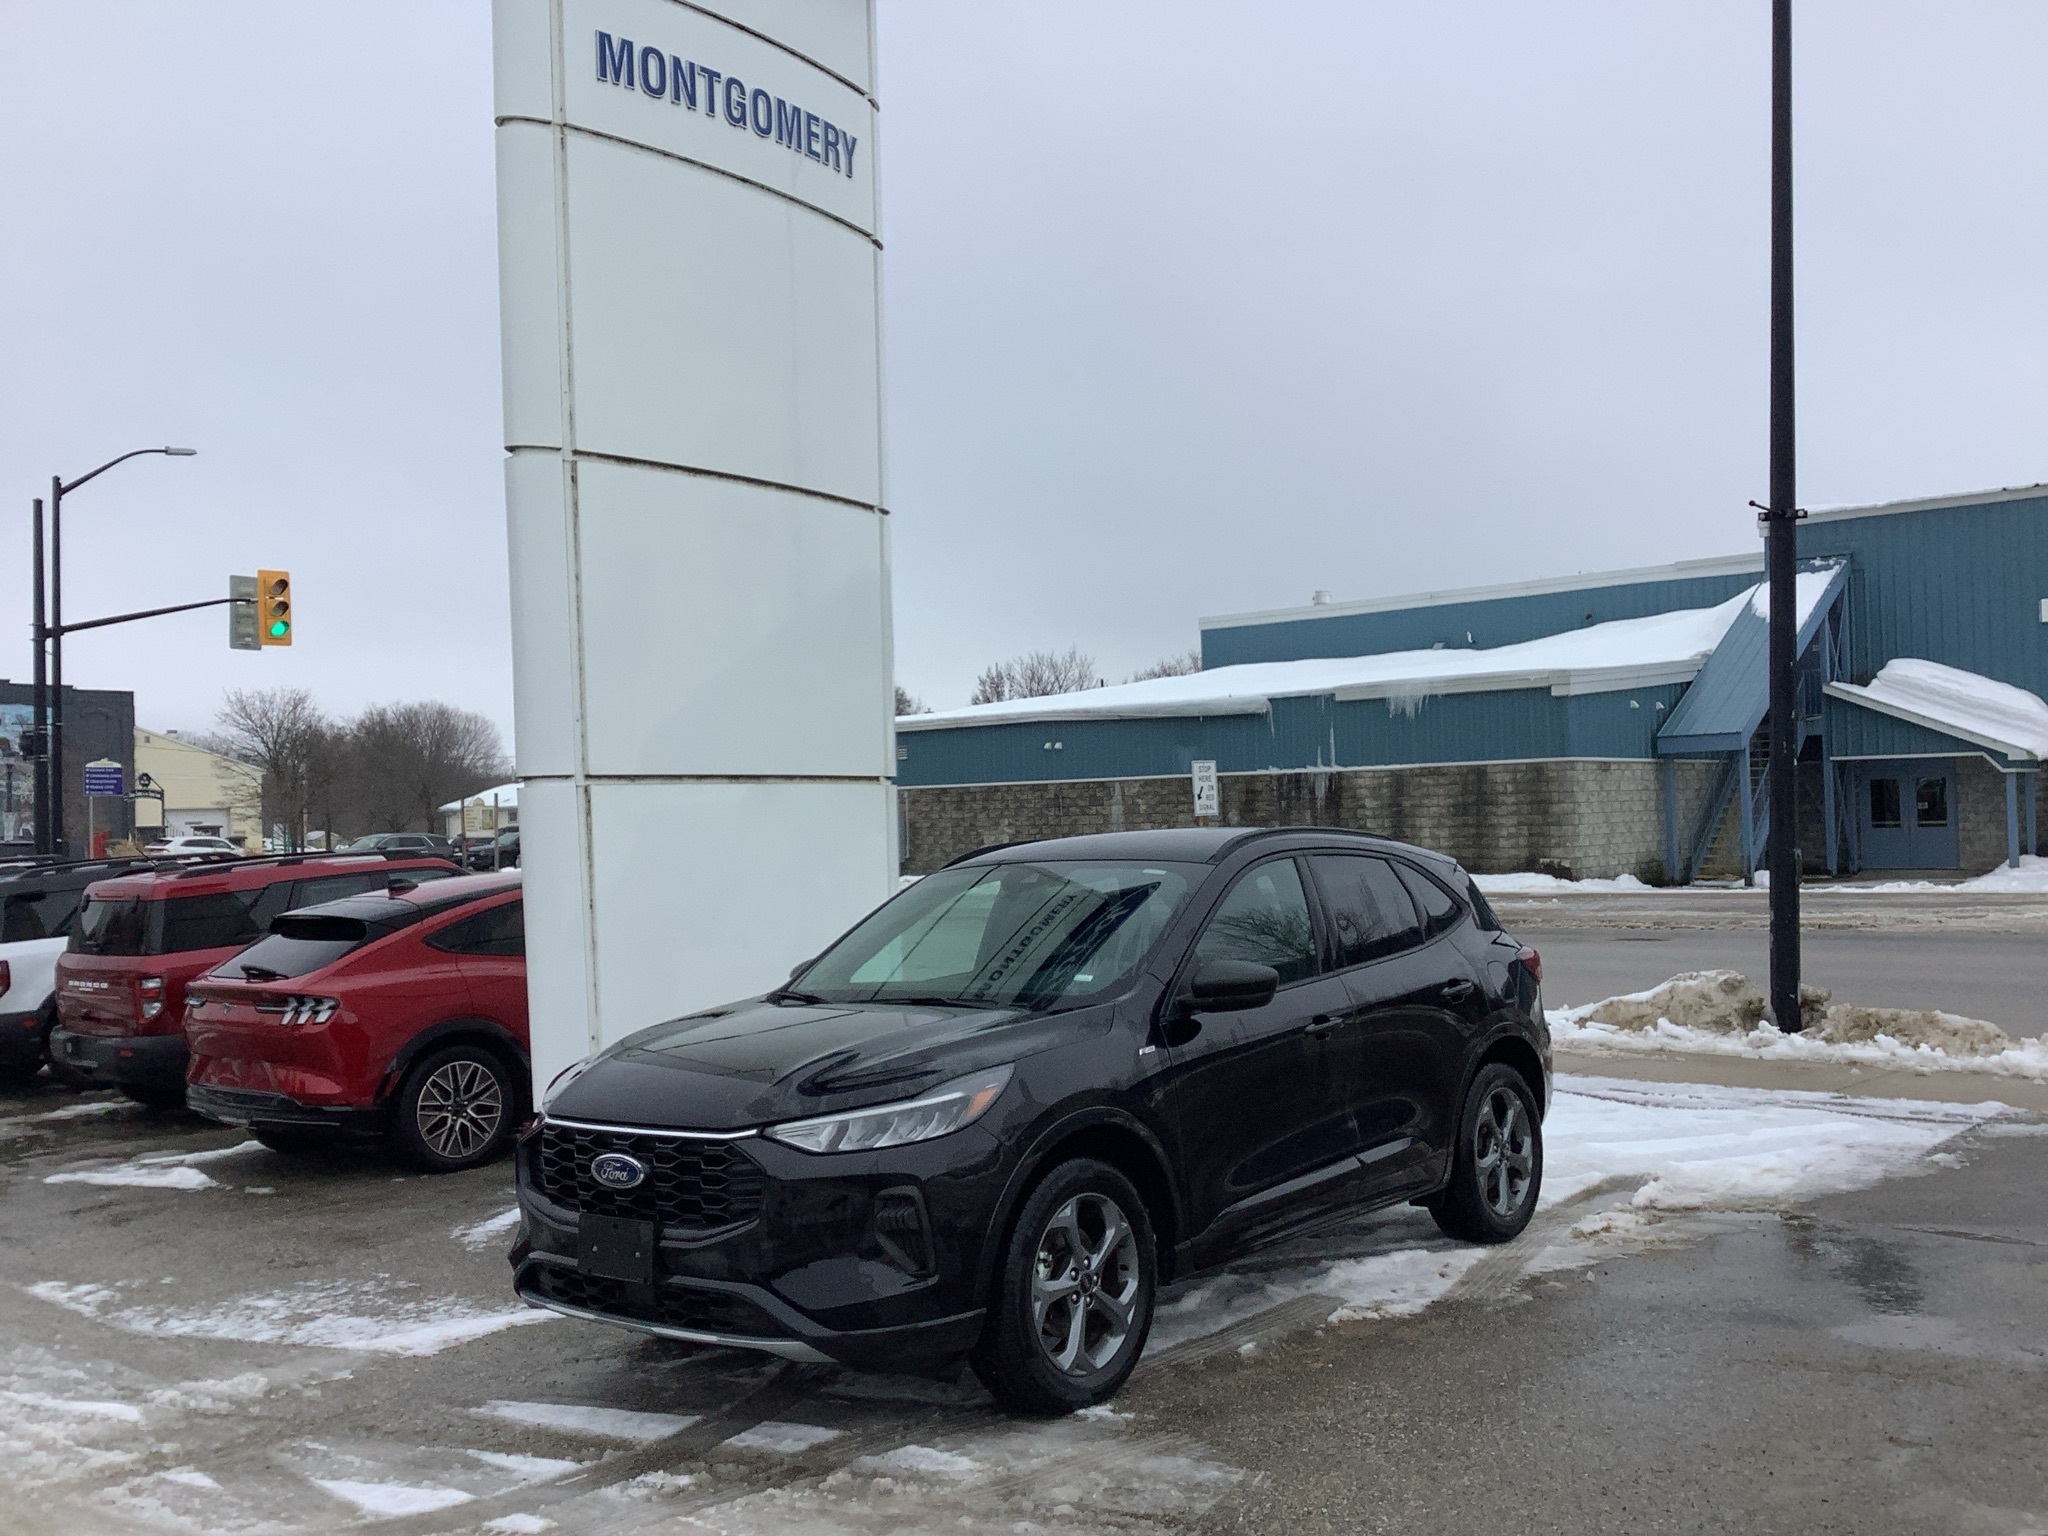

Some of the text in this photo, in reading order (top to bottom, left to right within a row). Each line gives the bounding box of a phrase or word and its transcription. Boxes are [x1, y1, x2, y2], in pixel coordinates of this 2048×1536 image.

[595, 29, 857, 178] MONTGOMERY
[1198, 765, 1212, 773] STOP
[1198, 775, 1212, 783] HERE
[1207, 784, 1215, 792] ON
[1205, 794, 1215, 802] RED
[601, 1161, 630, 1181] Ford
